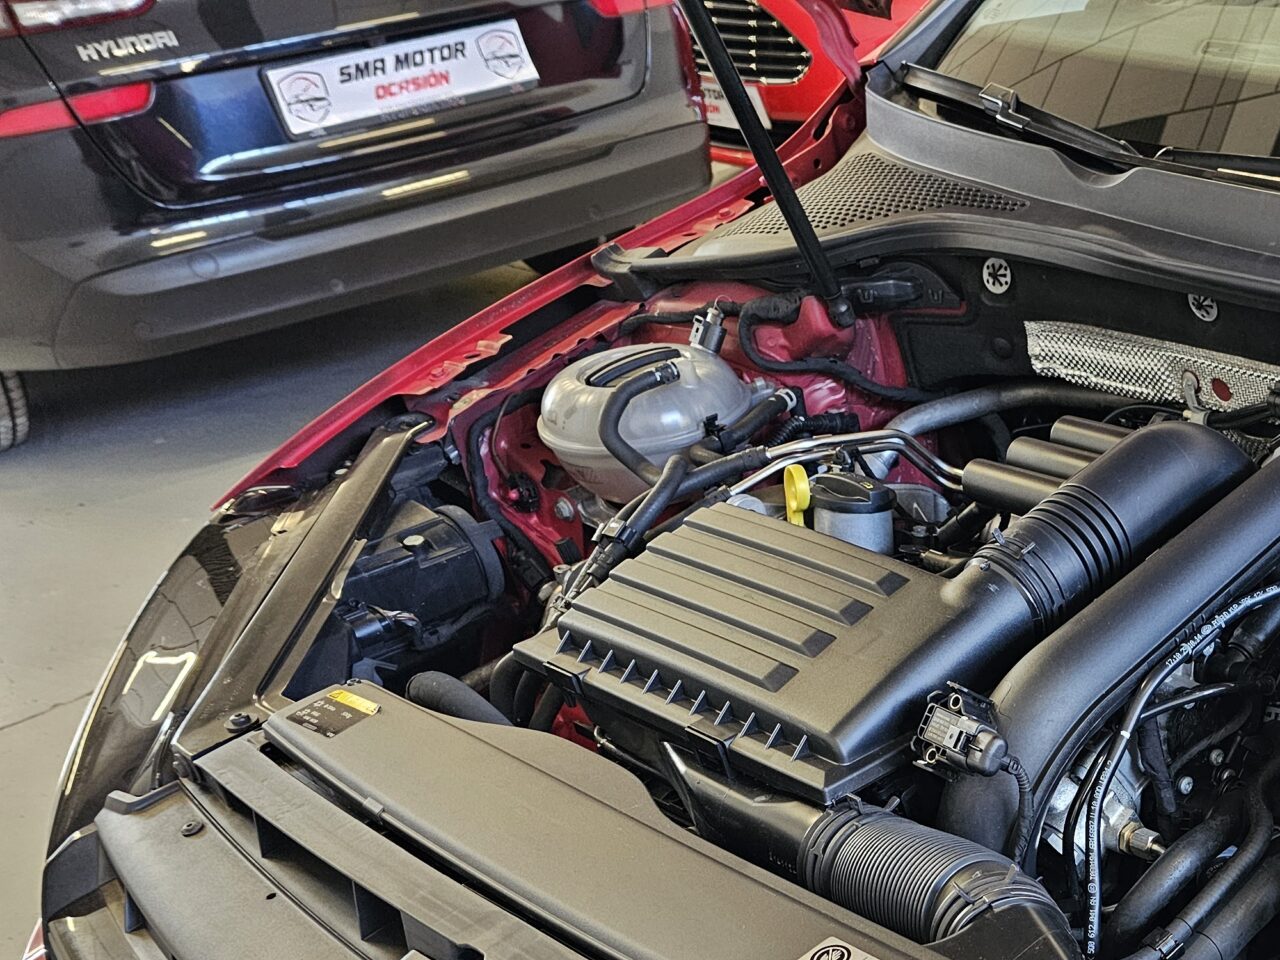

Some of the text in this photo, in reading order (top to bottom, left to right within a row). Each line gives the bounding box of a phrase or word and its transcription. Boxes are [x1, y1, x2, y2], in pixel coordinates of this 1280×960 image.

[76, 31, 179, 62] HYUNDAI
[395, 41, 467, 72] MOTOR
[1087, 924, 1096, 939] 612
